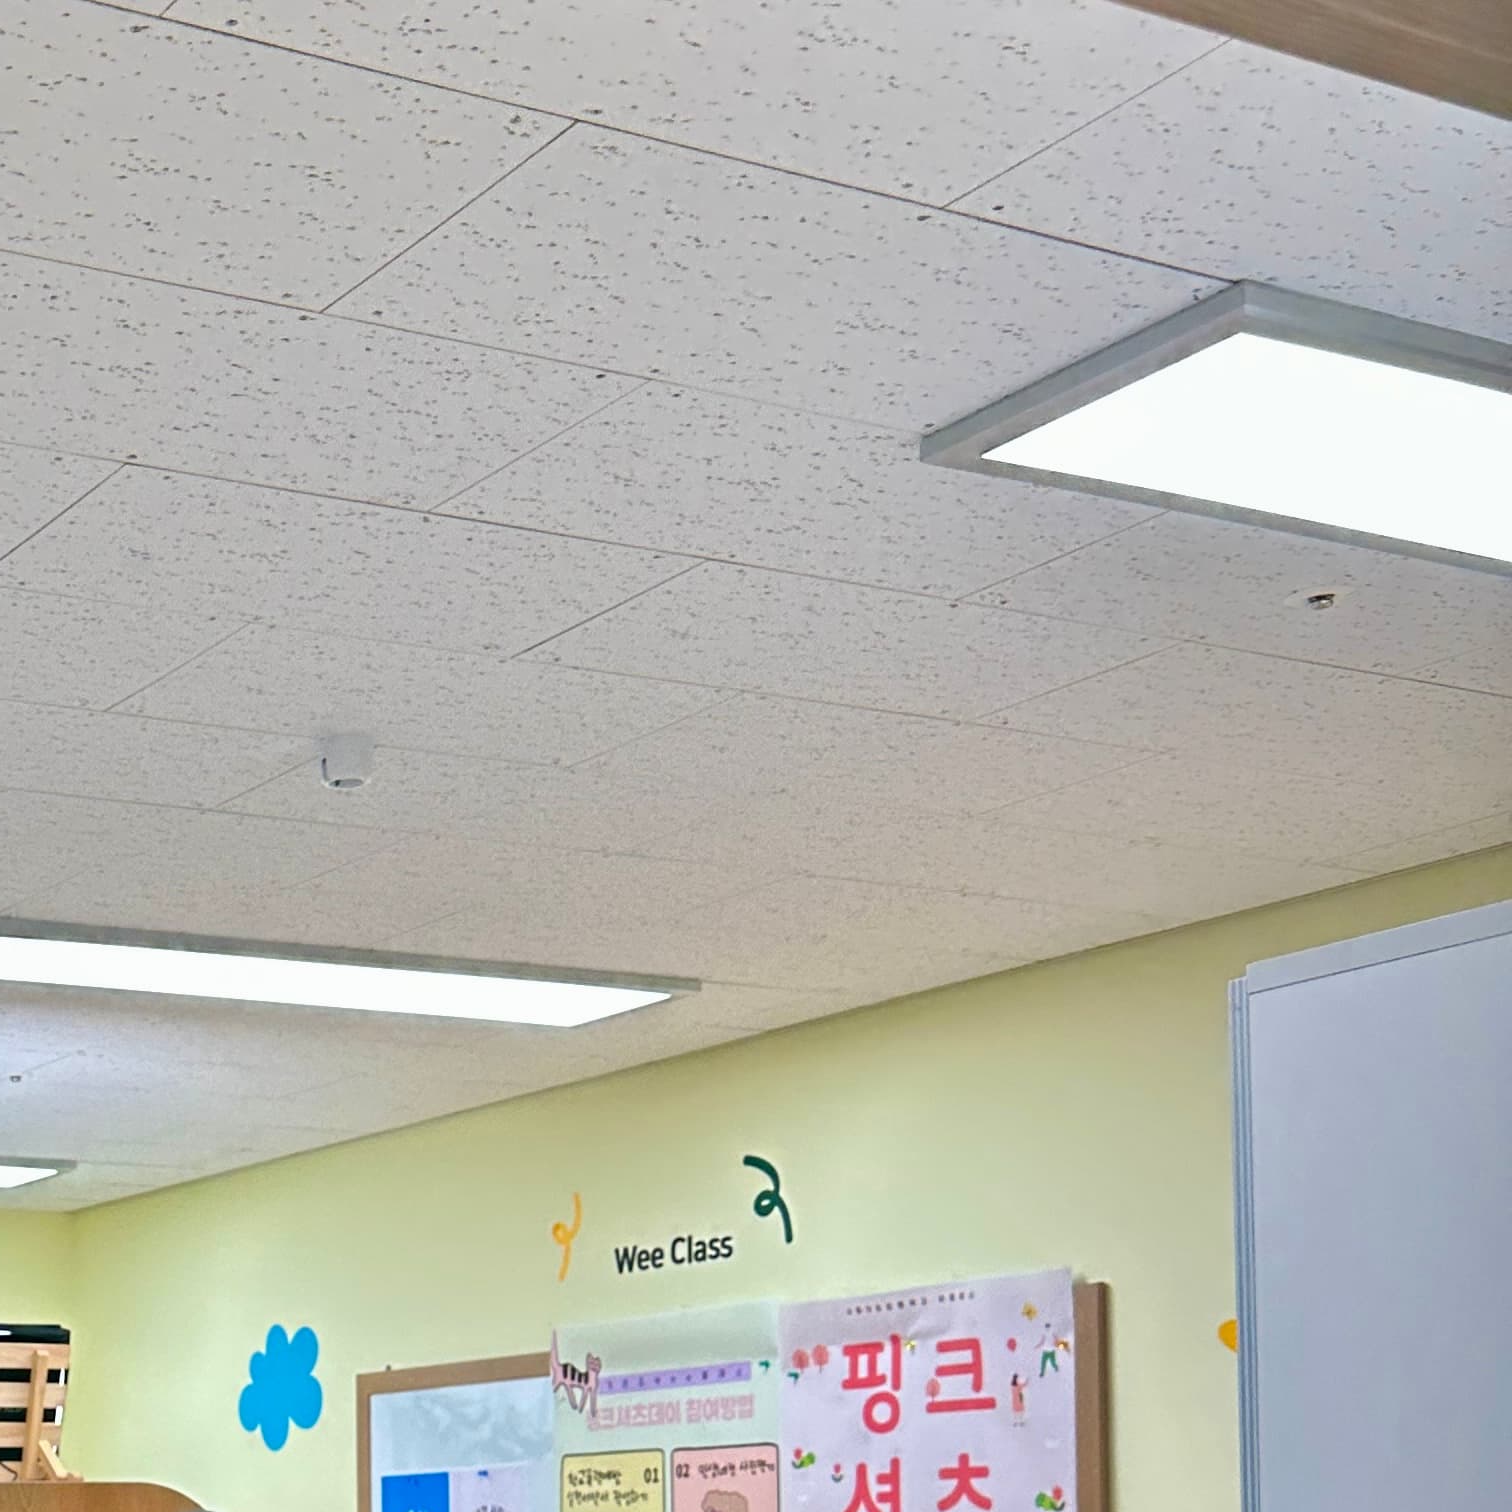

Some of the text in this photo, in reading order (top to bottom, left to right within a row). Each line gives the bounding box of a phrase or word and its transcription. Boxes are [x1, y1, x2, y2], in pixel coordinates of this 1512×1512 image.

[614, 1235, 734, 1274] Wee Class
[841, 1333, 997, 1434] 핑크
[643, 1467, 660, 1483] 01
[675, 1463, 690, 1478] 02
